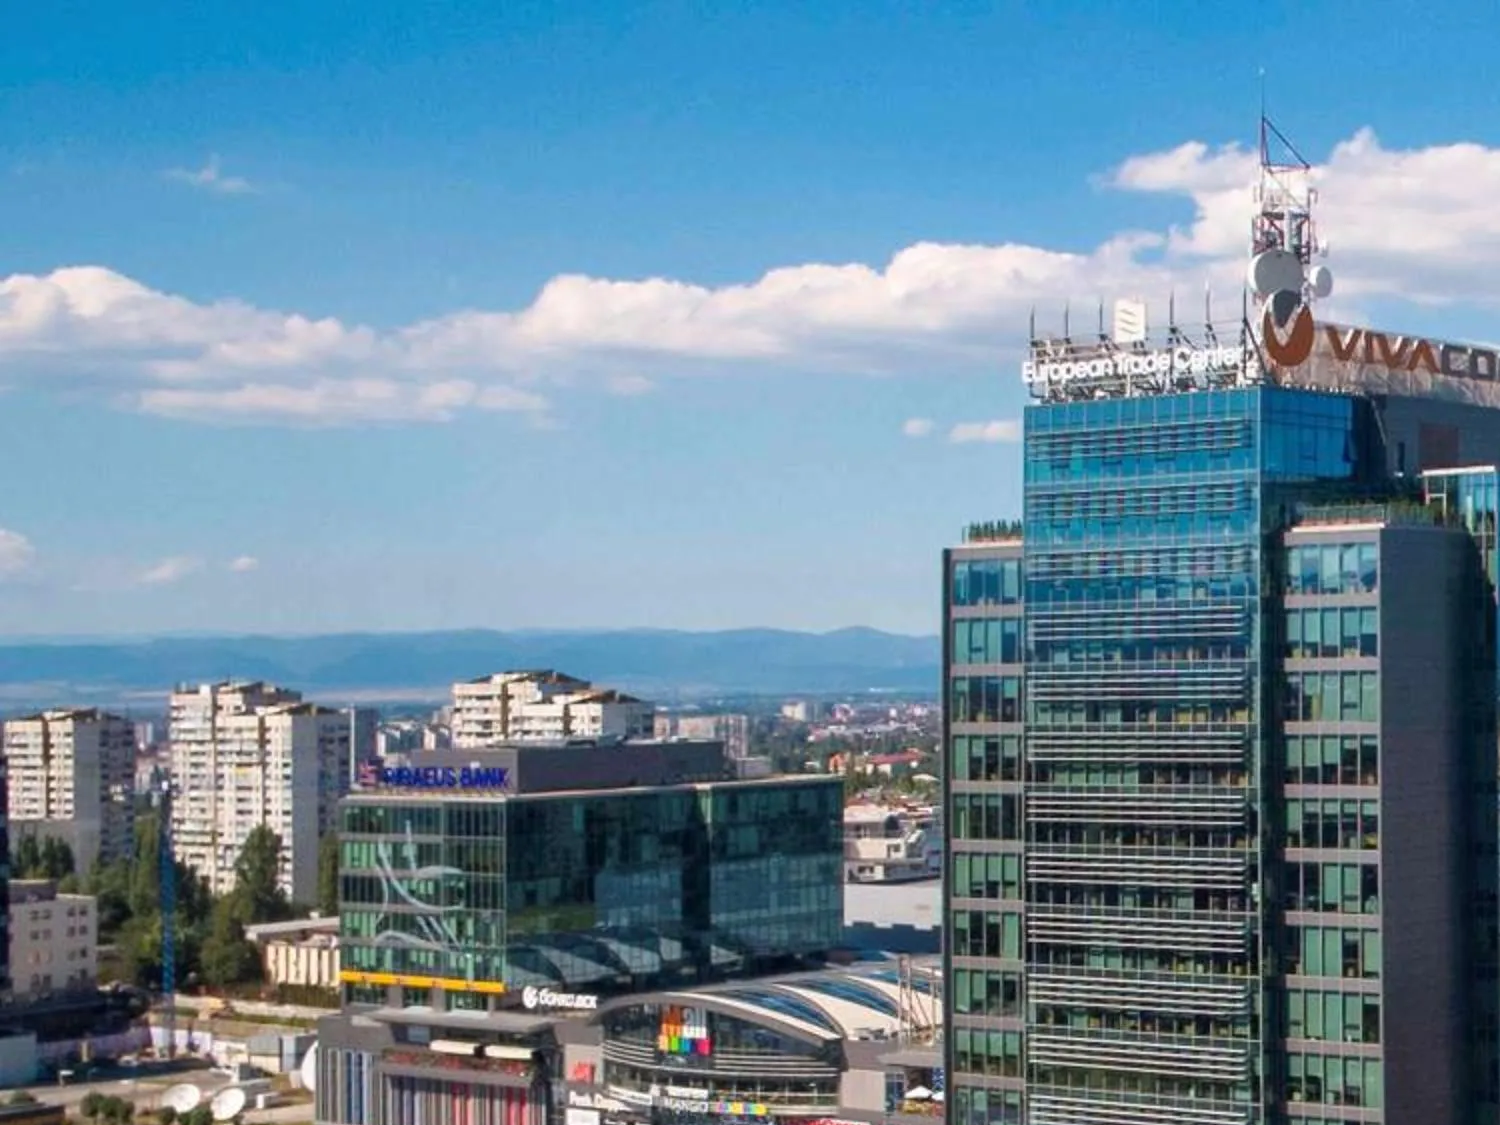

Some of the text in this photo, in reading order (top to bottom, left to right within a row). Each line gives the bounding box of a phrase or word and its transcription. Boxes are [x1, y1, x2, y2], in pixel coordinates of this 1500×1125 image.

[1022, 357, 1113, 386] European
[1113, 353, 1171, 376] Trade
[459, 766, 509, 789] BANK
